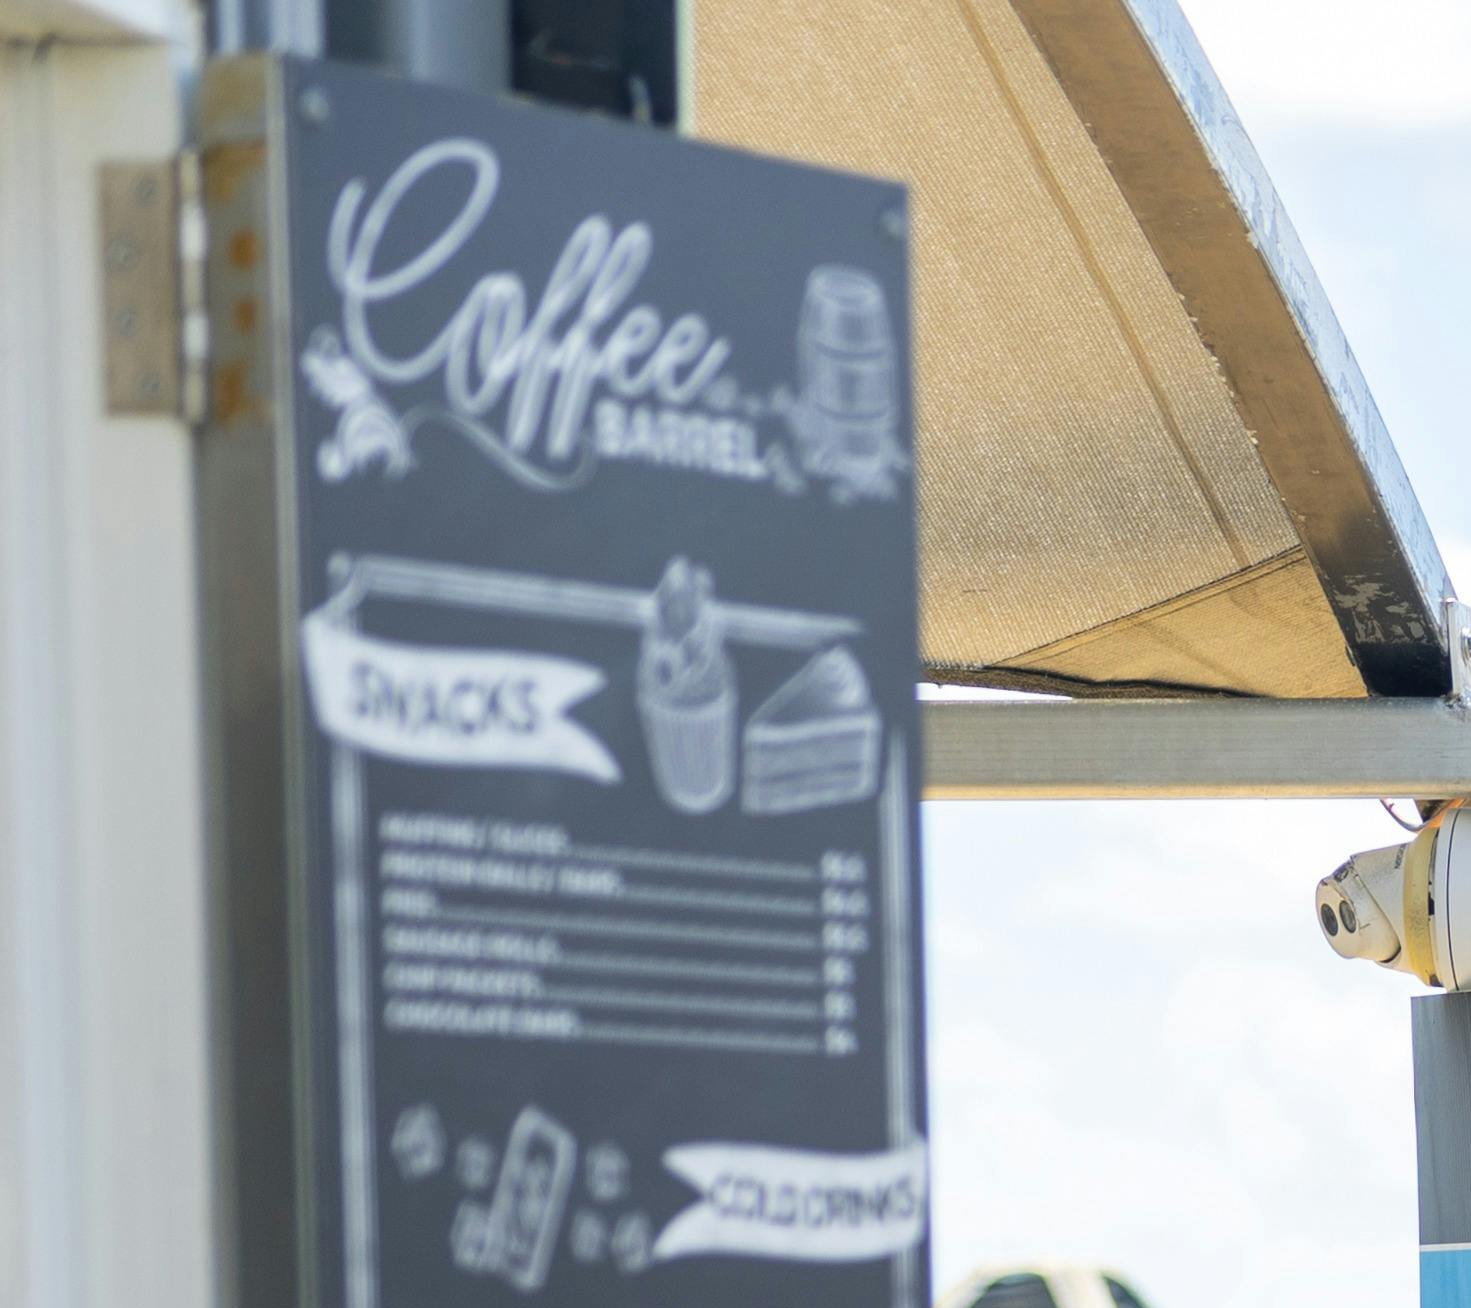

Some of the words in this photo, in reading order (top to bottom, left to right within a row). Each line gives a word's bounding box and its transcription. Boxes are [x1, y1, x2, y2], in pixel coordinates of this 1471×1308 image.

[328, 139, 732, 460] Coffee
[597, 404, 769, 479] BARREL
[350, 665, 540, 738] SNACKS
[711, 1174, 797, 1226] COLD
[800, 1176, 916, 1230] DRINKS
